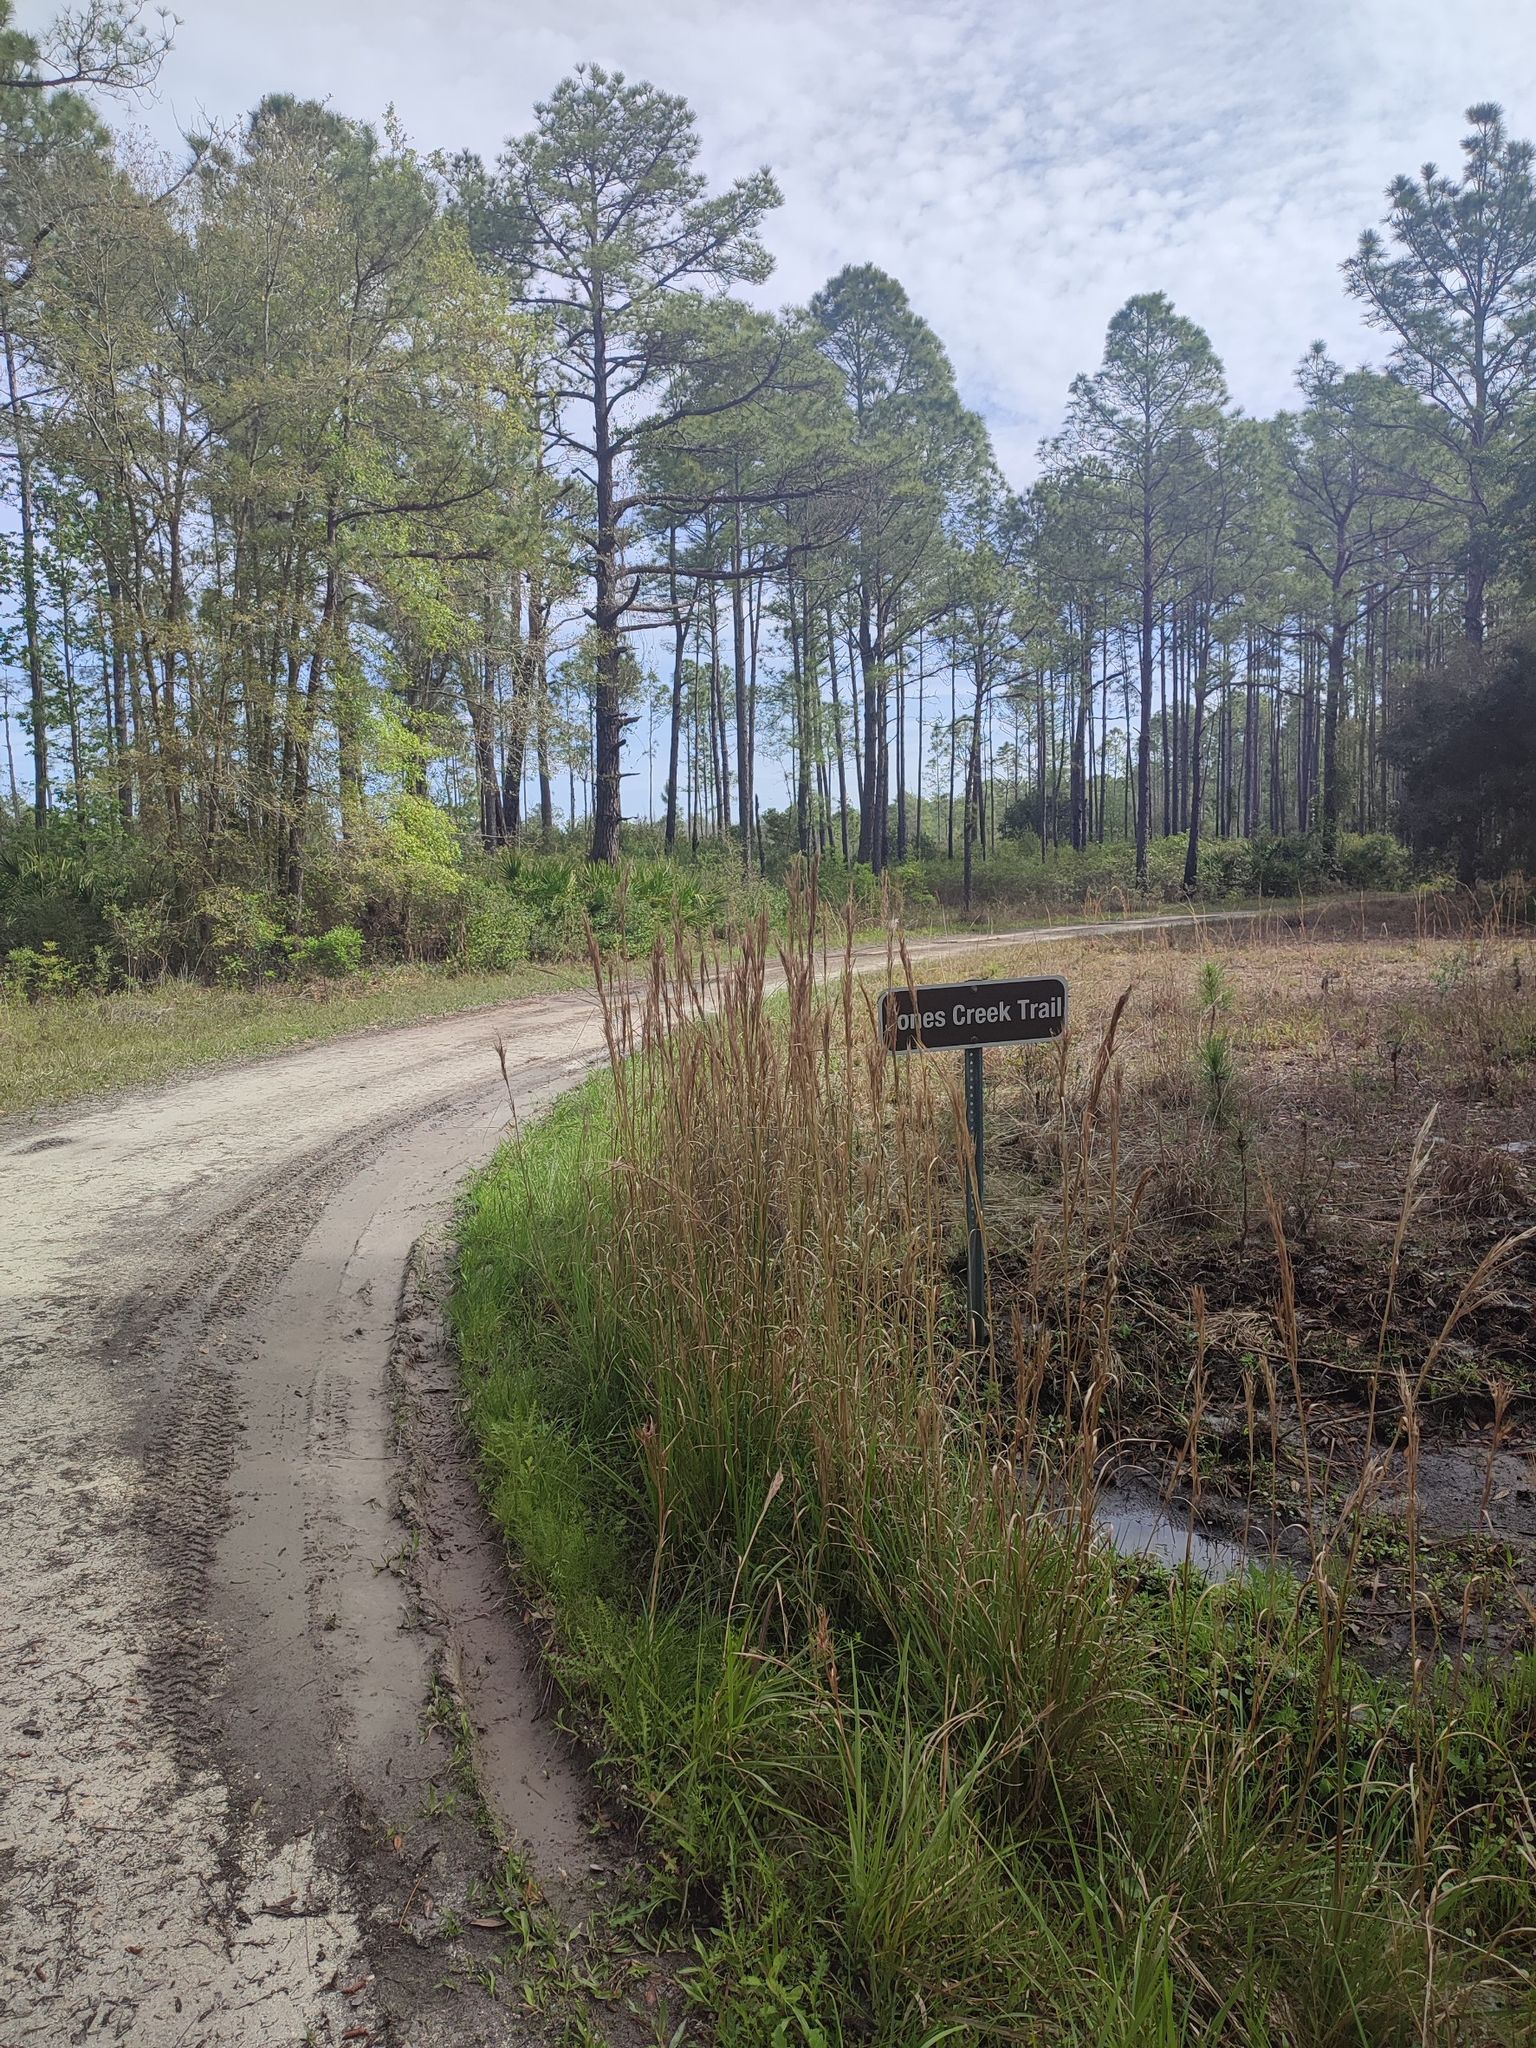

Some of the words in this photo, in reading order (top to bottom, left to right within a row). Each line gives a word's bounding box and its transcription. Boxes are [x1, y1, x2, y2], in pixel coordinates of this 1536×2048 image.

[889, 1010, 946, 1031] ones
[952, 1001, 1012, 1026] Creek
[1017, 996, 1062, 1020] Trail
